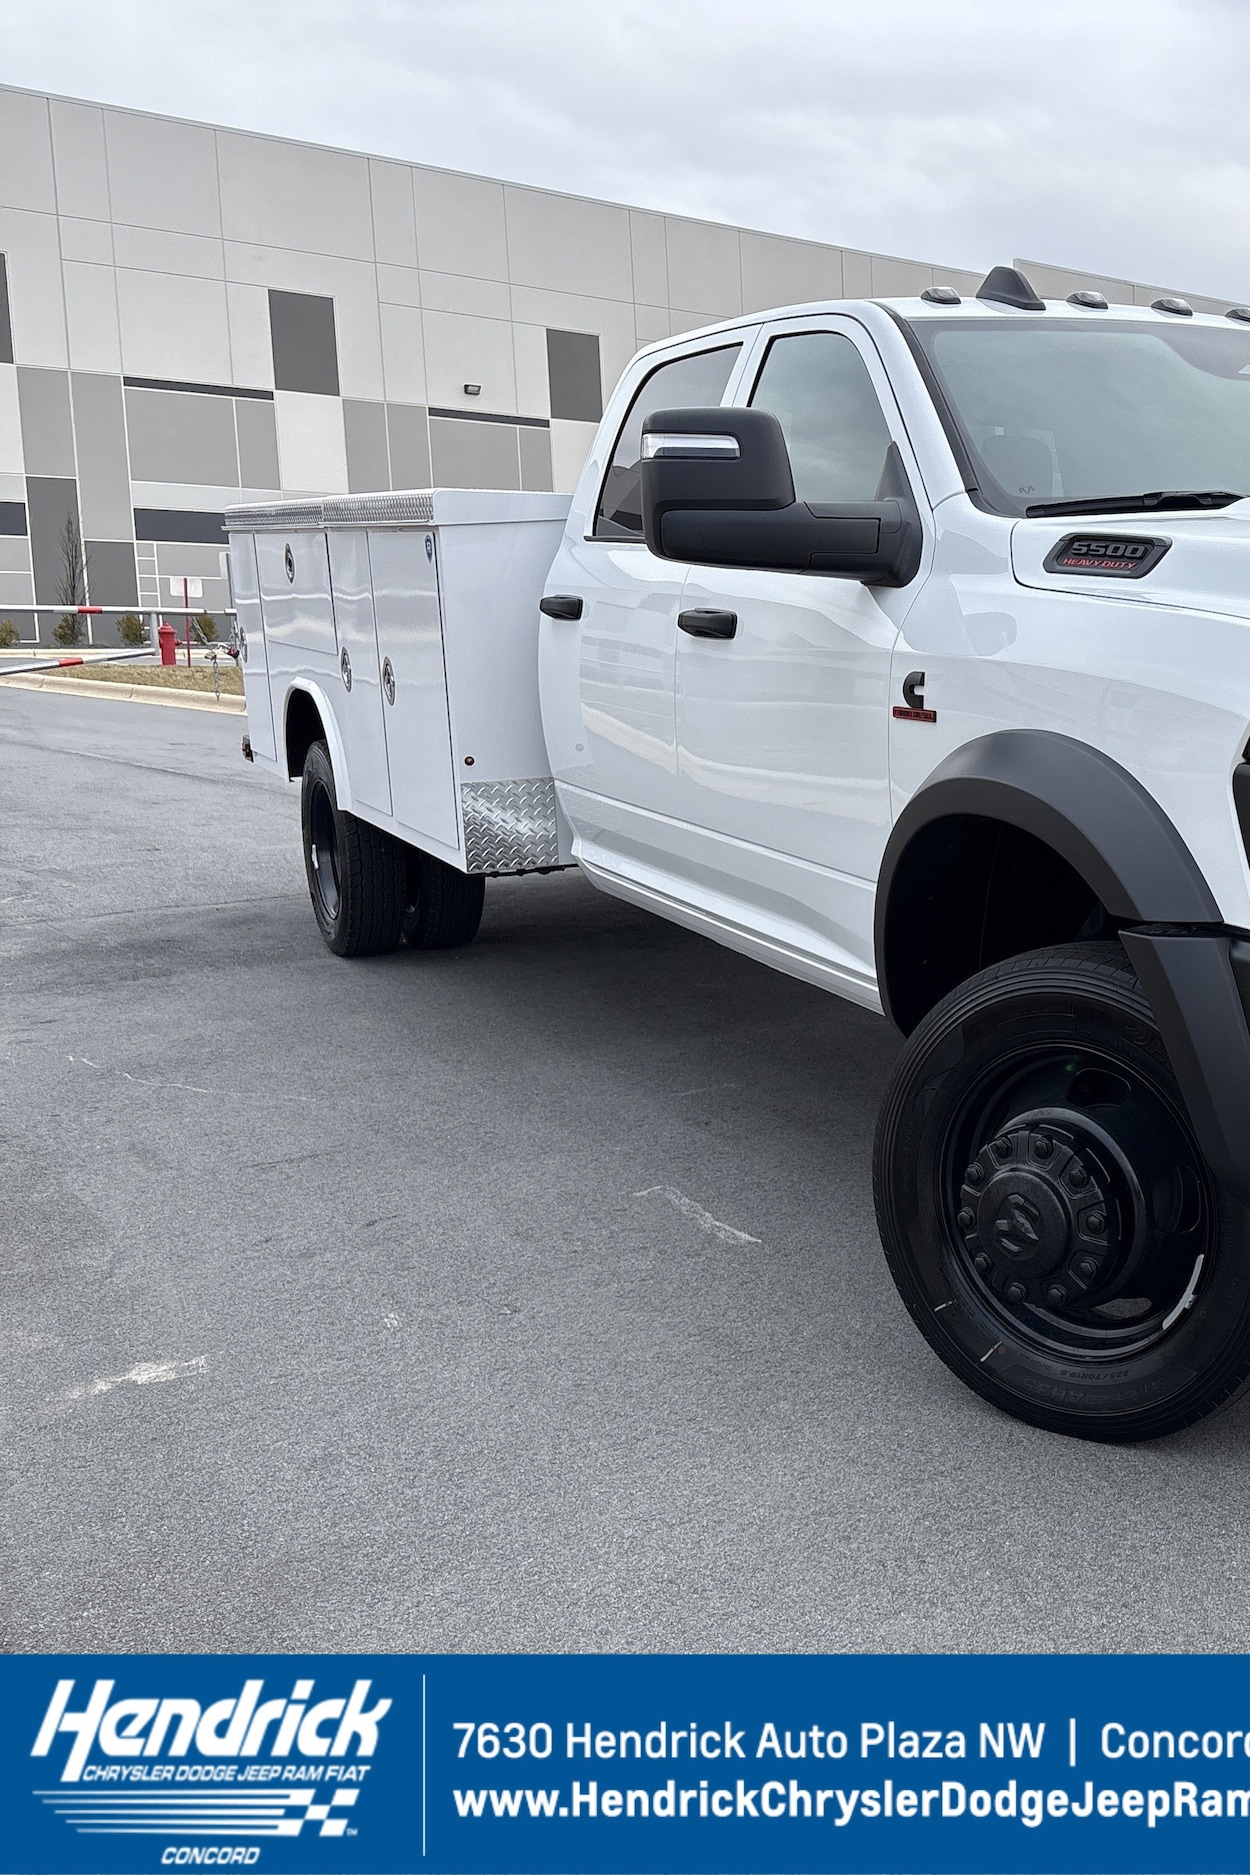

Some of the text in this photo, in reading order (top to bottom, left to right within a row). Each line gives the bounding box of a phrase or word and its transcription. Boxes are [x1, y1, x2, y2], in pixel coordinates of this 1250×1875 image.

[1071, 541, 1147, 559] 5500
[1062, 557, 1137, 570] HEAVY DUTY
